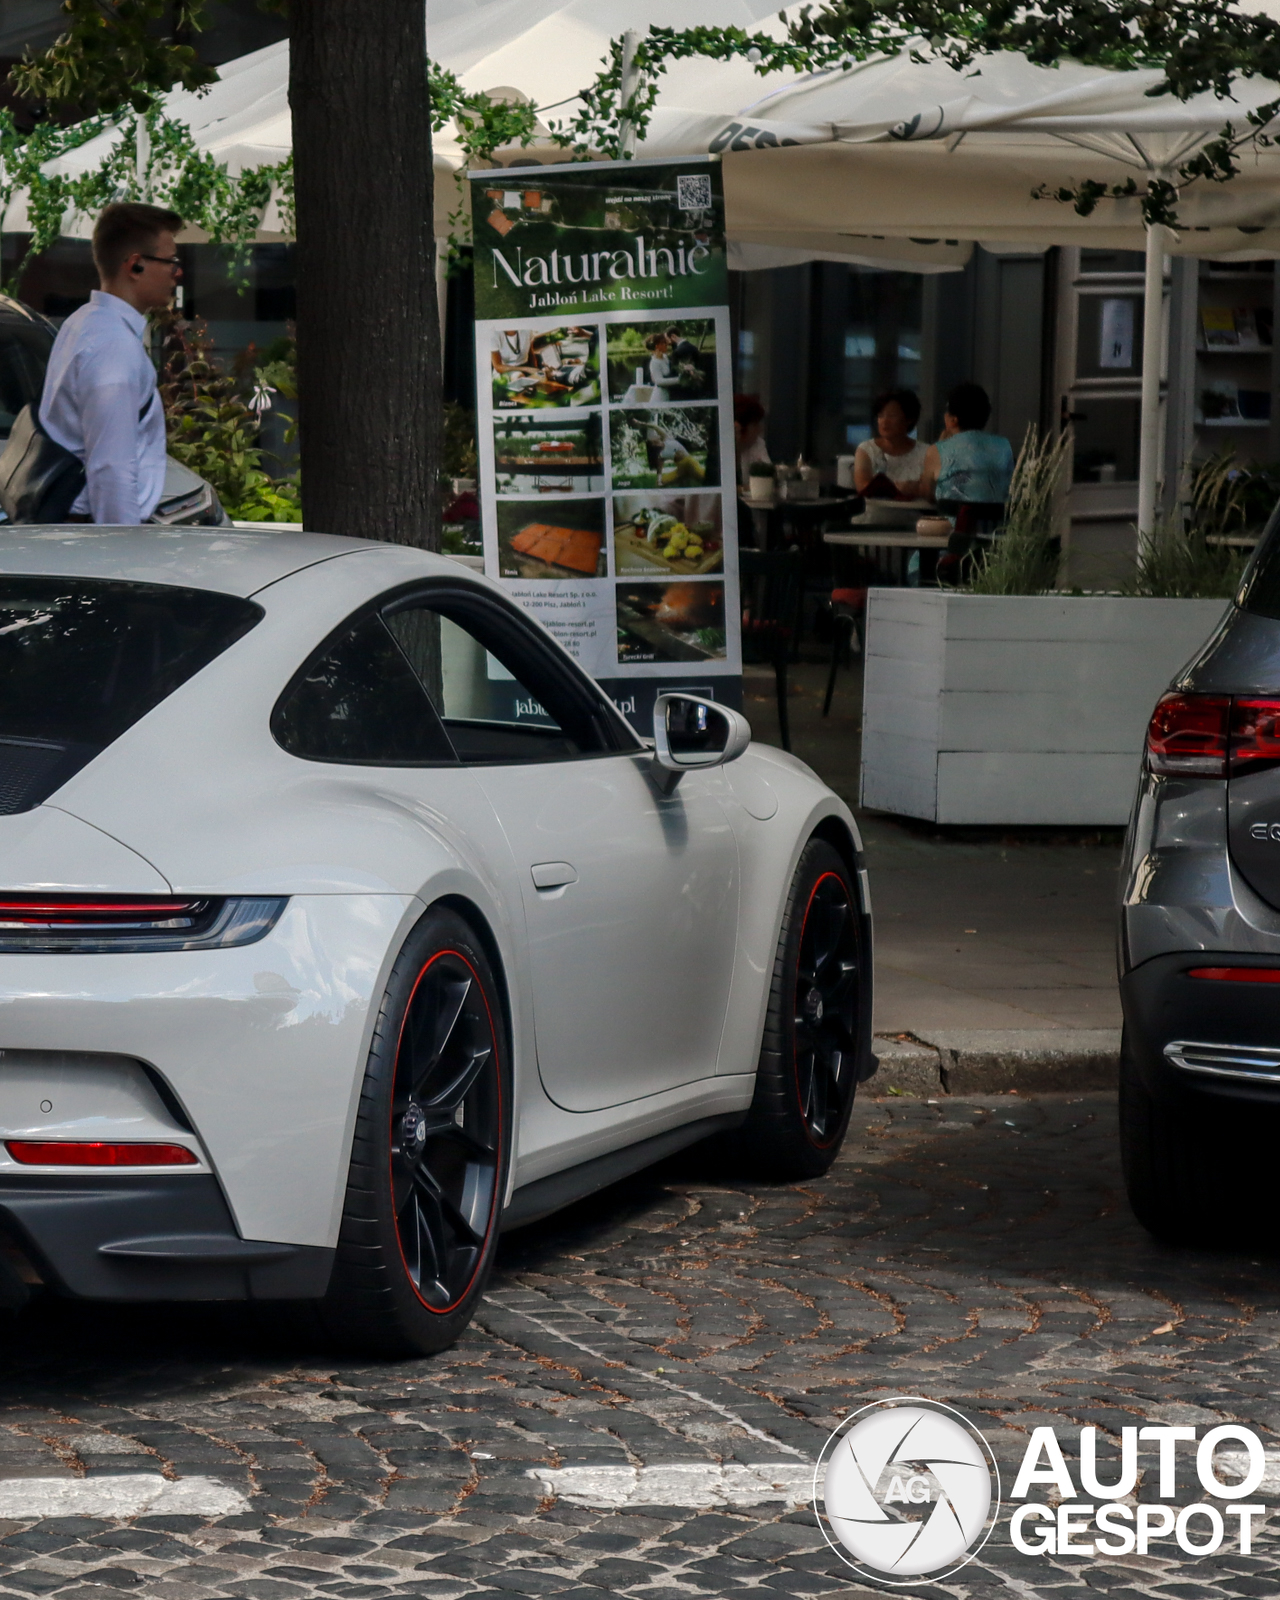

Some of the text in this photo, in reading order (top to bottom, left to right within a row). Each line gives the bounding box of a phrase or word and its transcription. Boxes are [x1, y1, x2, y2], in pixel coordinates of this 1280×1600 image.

[529, 285, 674, 309] Jabłoń Lake Resort!
